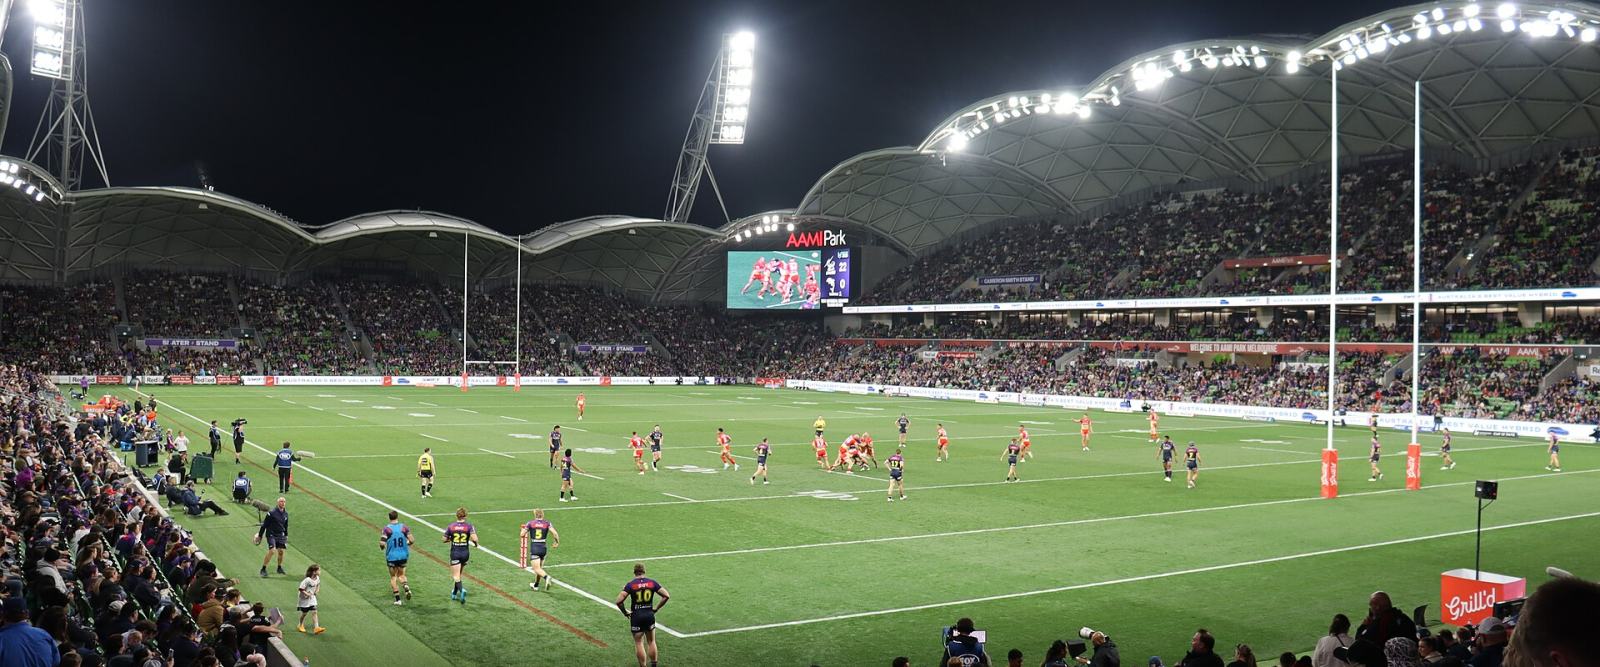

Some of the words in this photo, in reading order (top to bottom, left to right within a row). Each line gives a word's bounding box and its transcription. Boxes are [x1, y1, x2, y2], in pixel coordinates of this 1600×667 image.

[838, 261, 848, 272] 22
[839, 278, 846, 289] 0
[1189, 343, 1213, 352] WELCOME
[1213, 343, 1219, 352] TO
[453, 533, 468, 543] 22
[535, 528, 543, 540] 5
[393, 537, 404, 549] 18
[636, 589, 652, 603] 10
[1445, 587, 1496, 621] Grill'd
